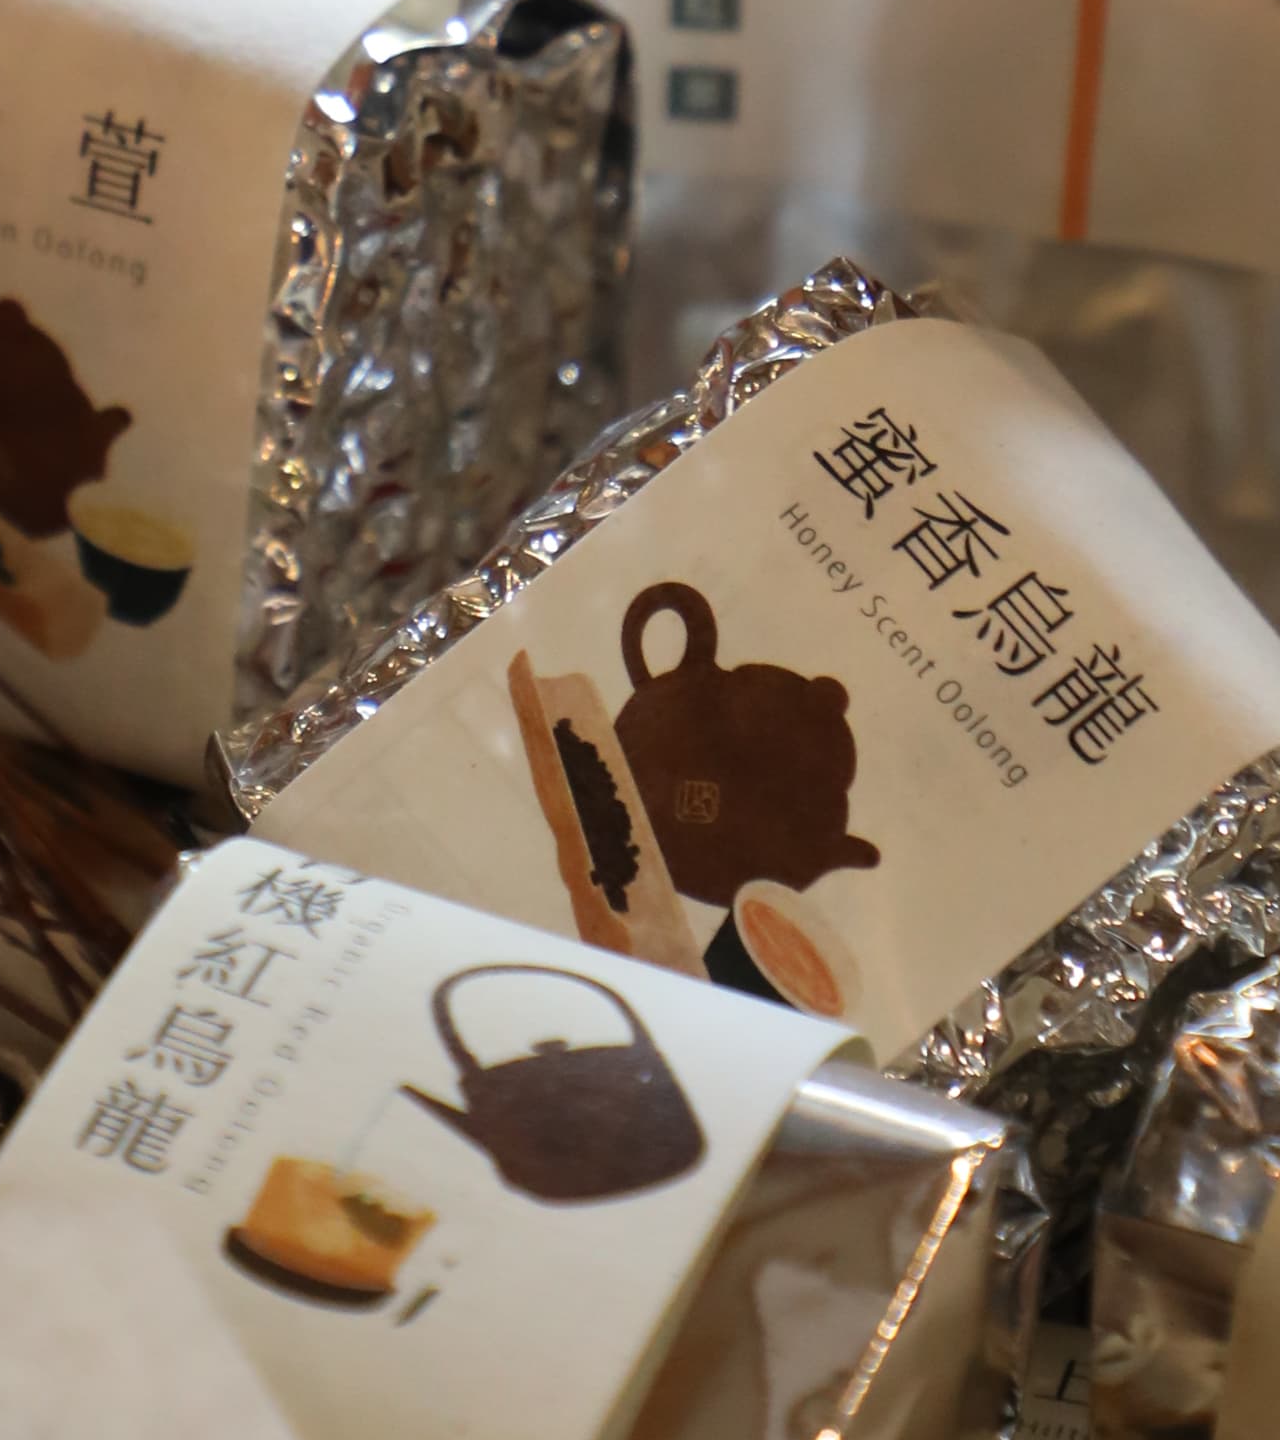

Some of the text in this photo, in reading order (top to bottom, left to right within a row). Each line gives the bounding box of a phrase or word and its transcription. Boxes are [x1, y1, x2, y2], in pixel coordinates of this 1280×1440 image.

[778, 502, 1029, 789] Honey Scent Oolong
[813, 407, 1160, 765] 蜜香烏龍
[75, 862, 367, 1175] 機紅烏龍
